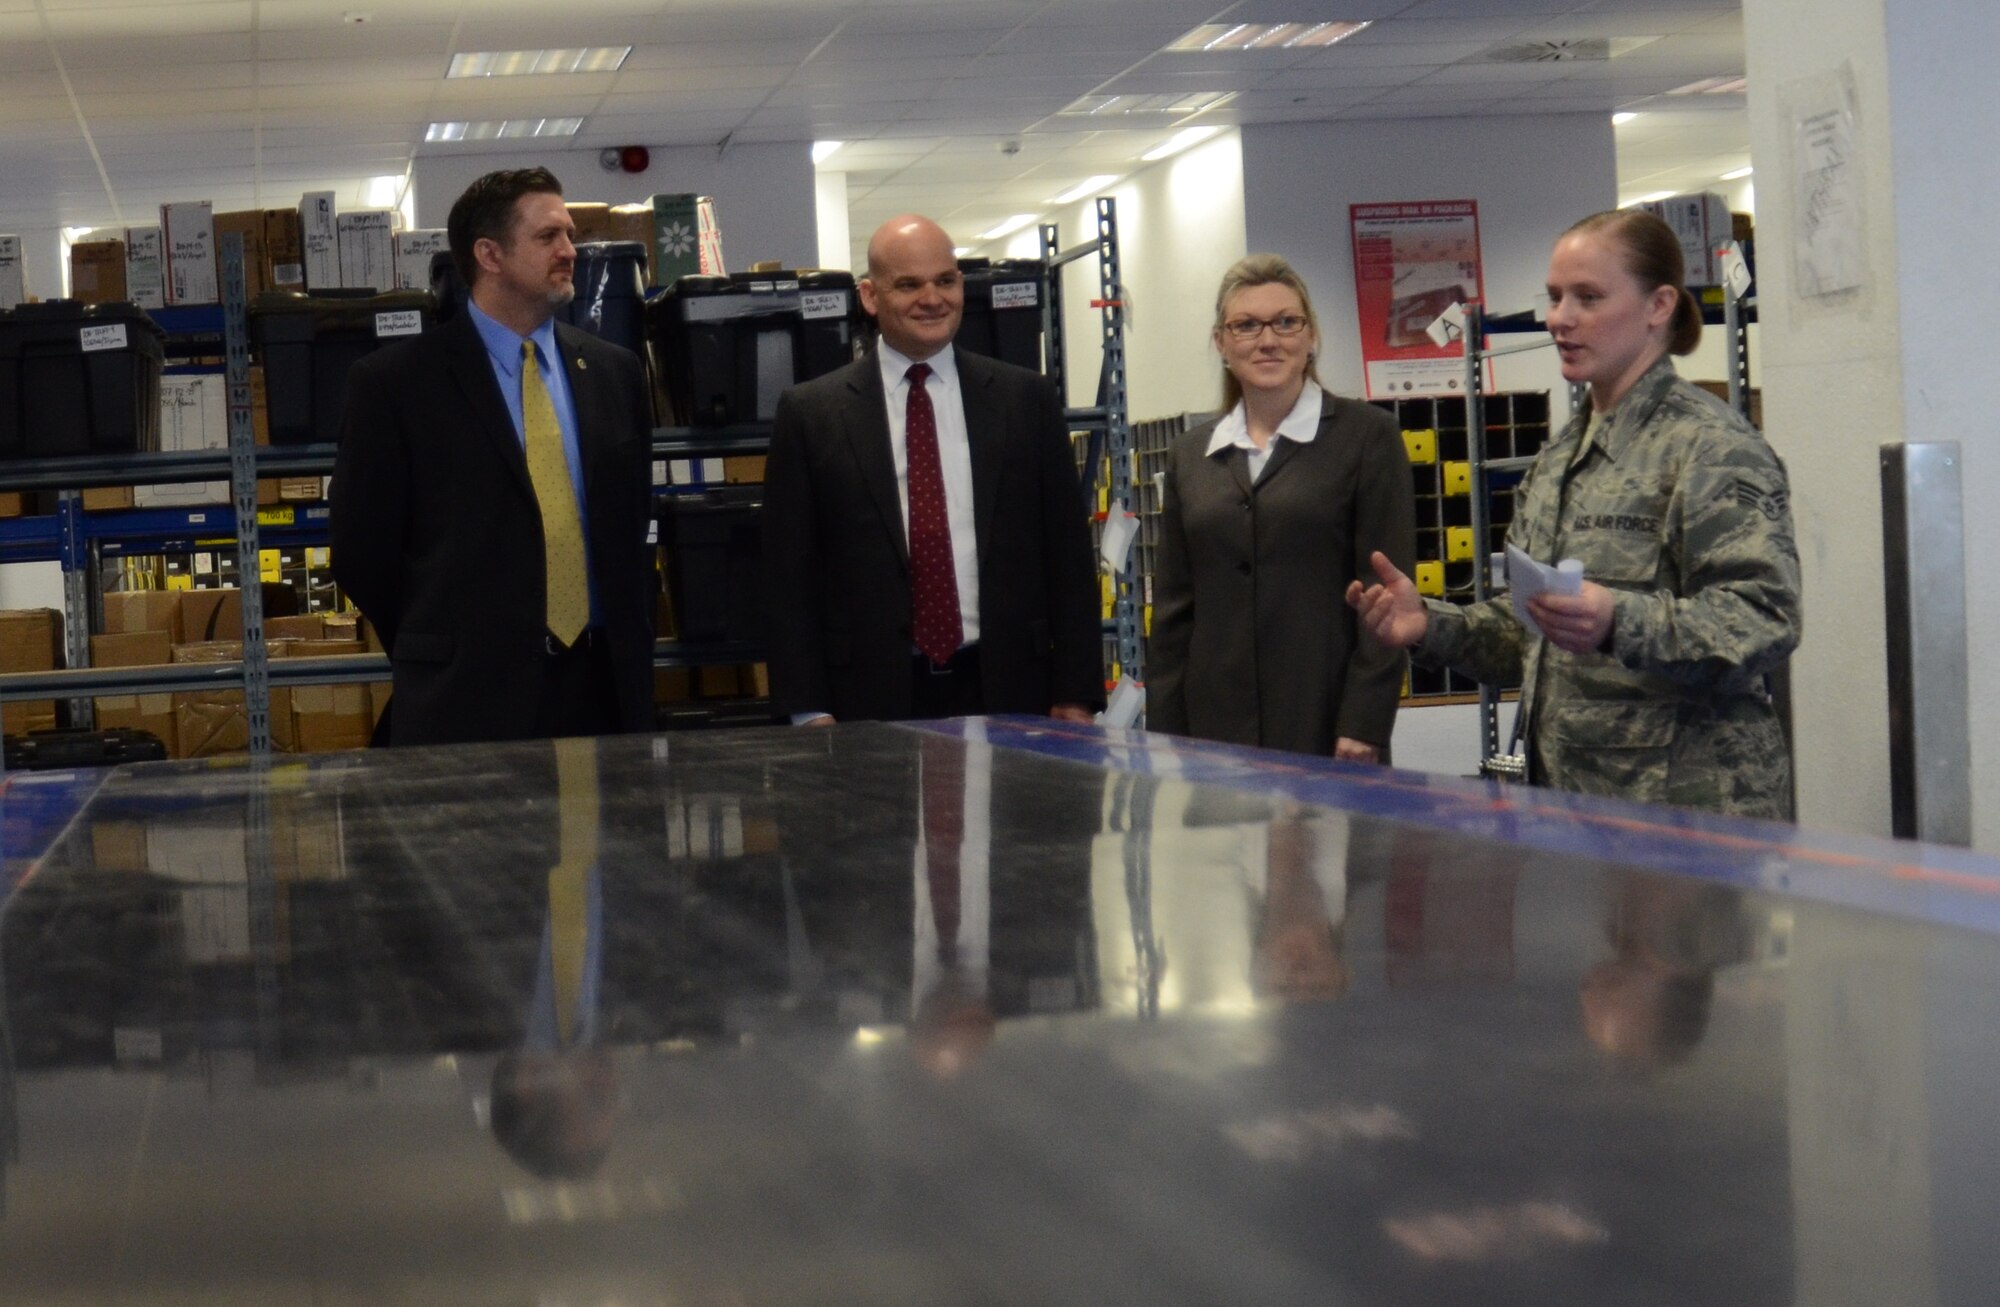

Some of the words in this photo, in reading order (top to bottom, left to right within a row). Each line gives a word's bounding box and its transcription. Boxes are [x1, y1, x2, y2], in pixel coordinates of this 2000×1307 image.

[1443, 318, 1460, 341] A
[266, 511, 280, 519] 700
[1595, 515, 1613, 529] AIR
[1616, 515, 1658, 532] FORCE
